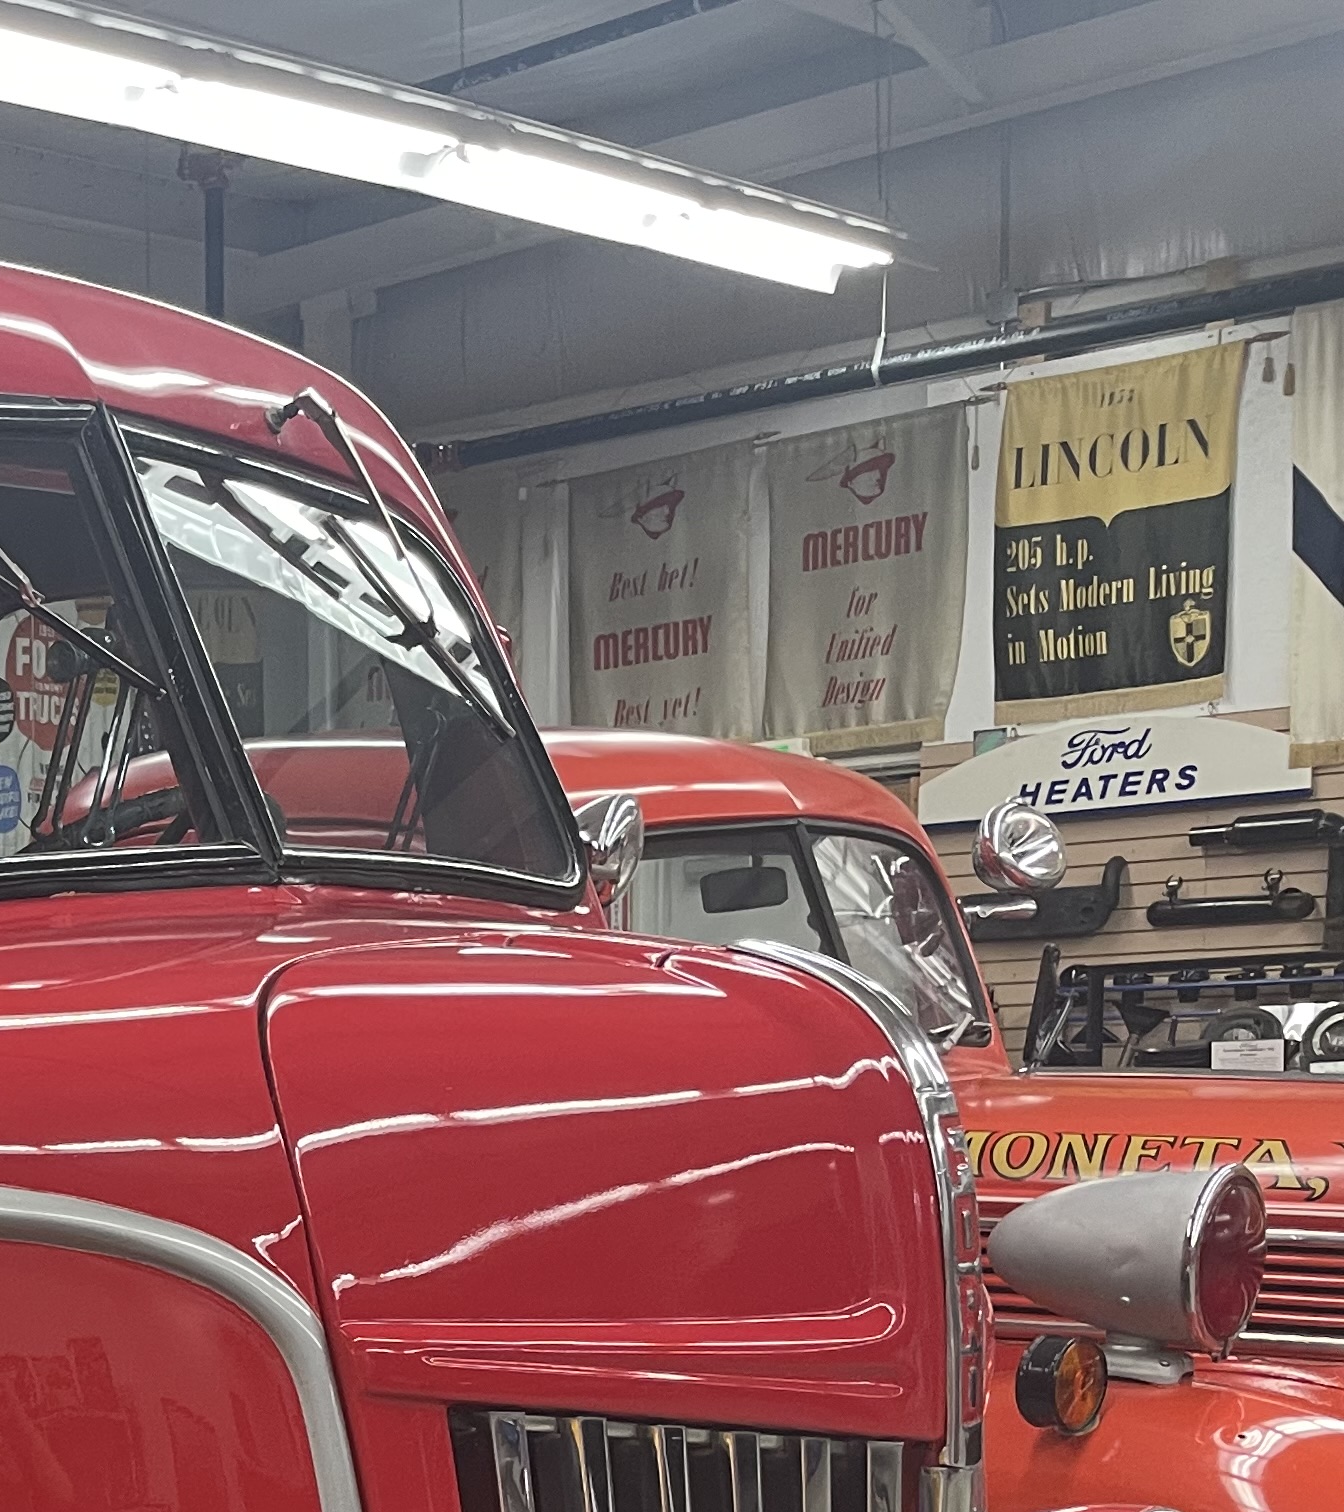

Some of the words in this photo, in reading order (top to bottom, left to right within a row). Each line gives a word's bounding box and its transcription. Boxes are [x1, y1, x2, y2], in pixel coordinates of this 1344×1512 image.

[1013, 413, 1214, 490] LINCOLN
[802, 512, 929, 572] MERCURY
[1006, 536, 1043, 572] 205
[1055, 533, 1094, 570] h.p.
[608, 570, 648, 602] Best
[658, 557, 699, 592] bet!
[1006, 583, 1049, 617] Sets
[1059, 575, 1135, 612] Modern
[1148, 561, 1216, 599] Living
[846, 585, 878, 619] for
[593, 614, 712, 671] MERCURY
[825, 624, 898, 664] Unified
[1007, 633, 1026, 665] in
[1039, 625, 1107, 662] Motion
[613, 696, 650, 728] Best
[657, 687, 701, 728] yet!
[821, 672, 886, 710] Design
[1061, 727, 1152, 769] Ford
[1018, 764, 1199, 807] HEATERS
